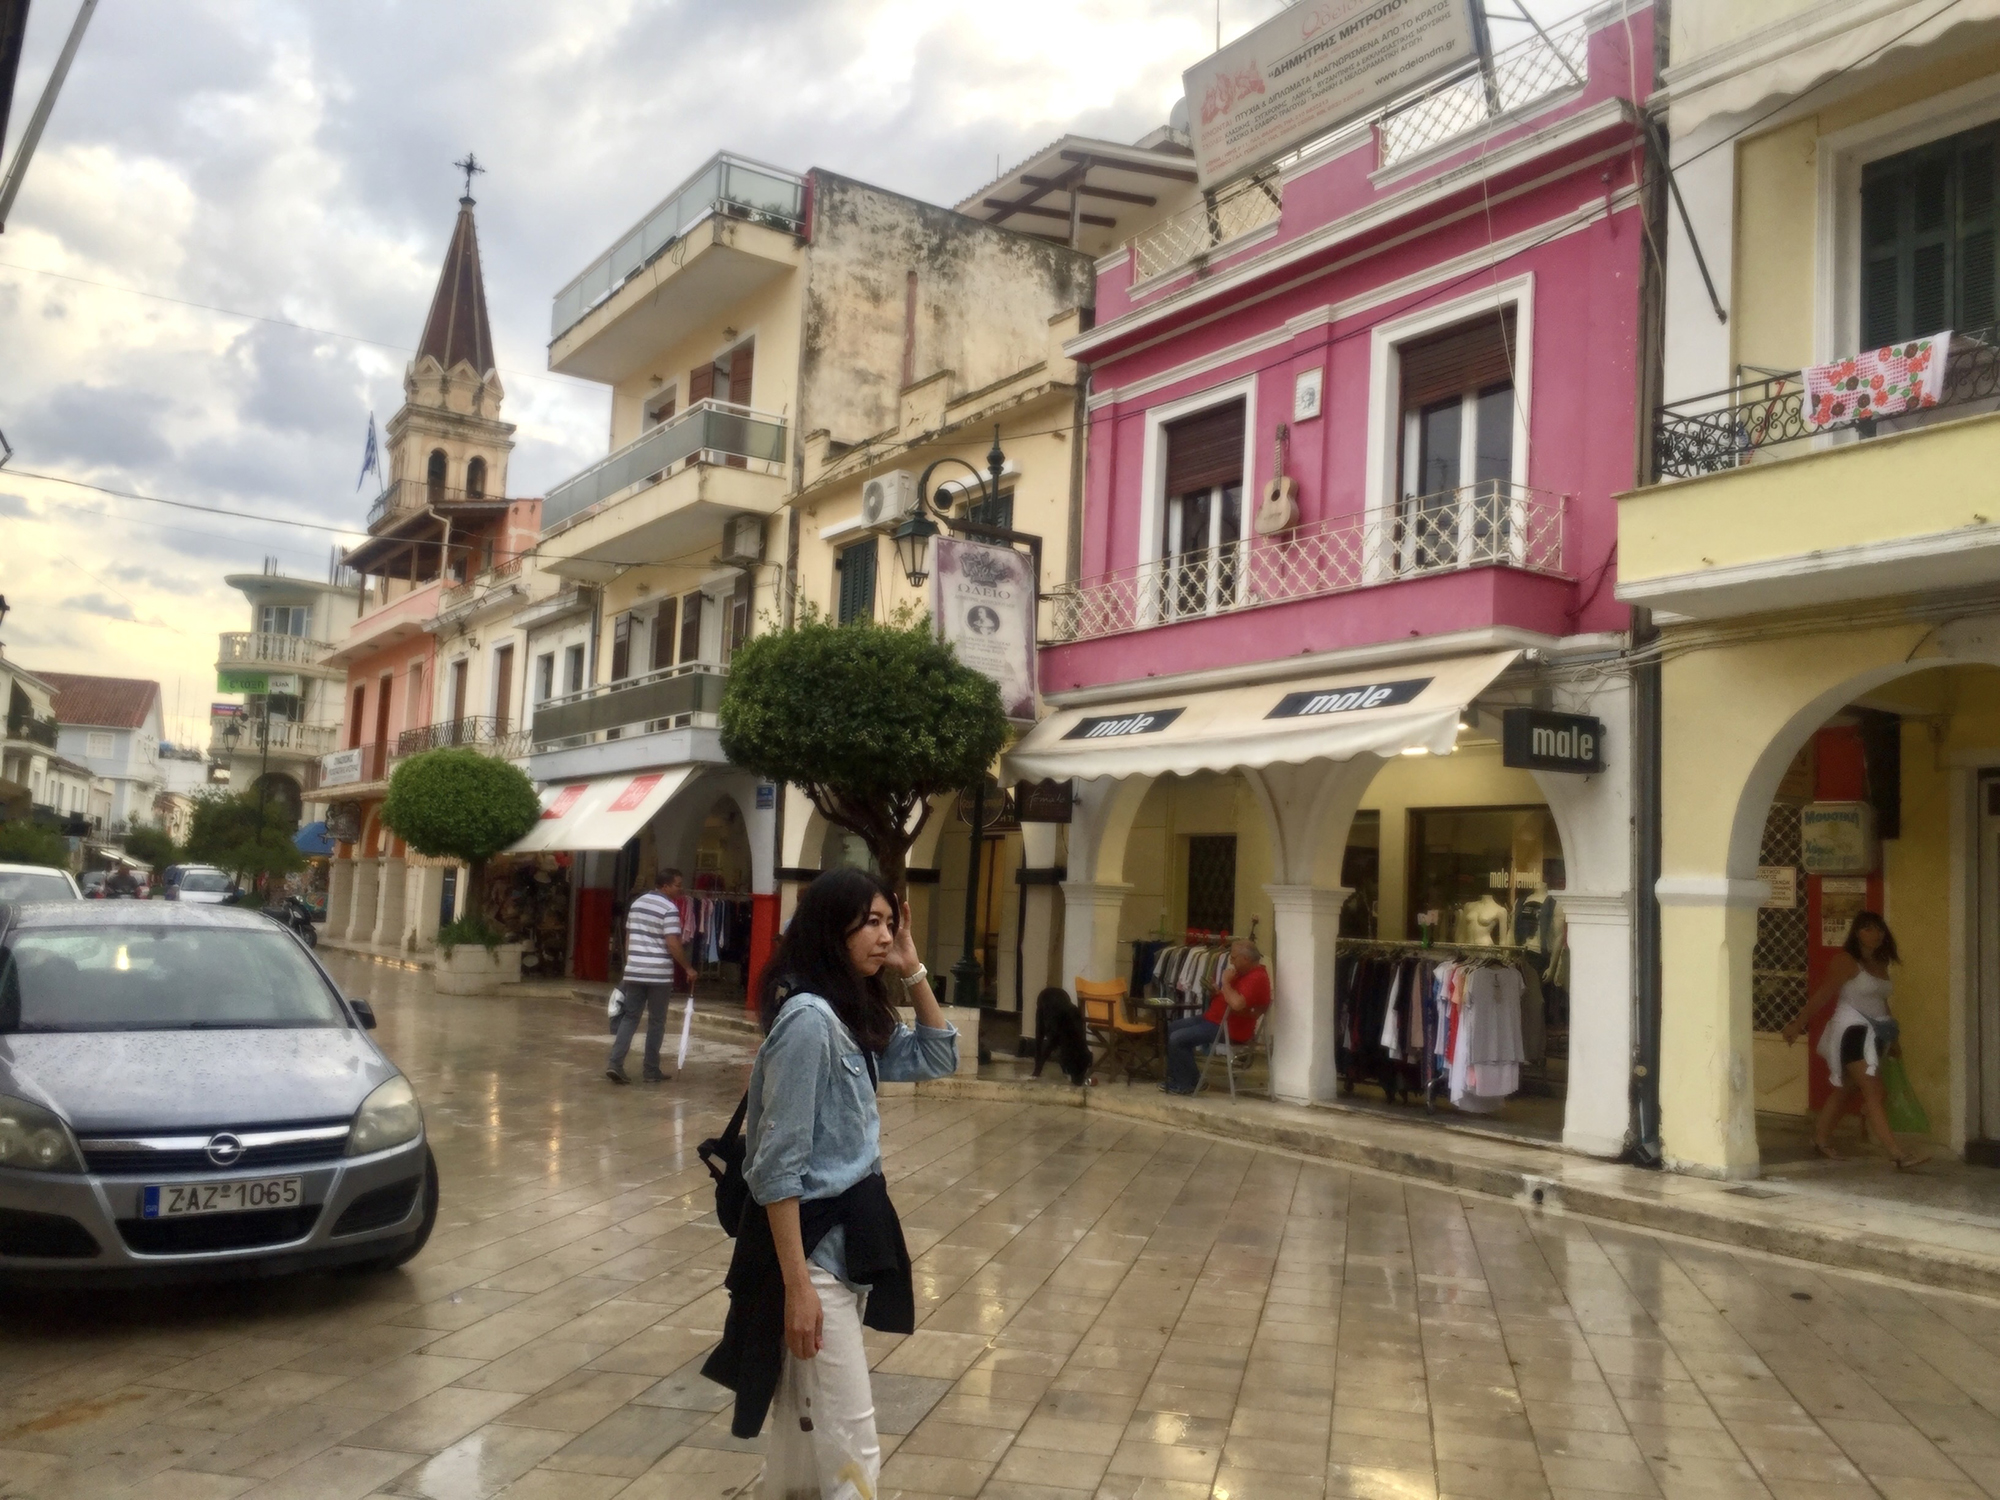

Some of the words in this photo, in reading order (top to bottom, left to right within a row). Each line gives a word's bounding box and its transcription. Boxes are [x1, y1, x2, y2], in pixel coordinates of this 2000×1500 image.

[1234, 102, 1260, 122] ΠΤΥΧΙΑ
[1267, 74, 1311, 104] ΔΙΠΛΩΜΑΤΑ
[1311, 37, 1379, 79] ΑΝΑΓΝΩΡΙΣΜΕΝΑ
[1380, 25, 1400, 41] ΑΠΟ
[1401, 18, 1413, 30] ΤΟ
[1414, 0, 1450, 23] ΚΡΑΤΟΣ
[1316, 62, 1355, 88] ΒΥΖΑΝΤΙΝΗΣ
[1415, 10, 1452, 34] ΜΟΥΣΙΚΗΣ
[1344, 47, 1399, 81] ΜΕΛΟΔΡΑΜΑΤΙΚΗ
[958, 583, 1011, 599] ΩΔΕΙΟ
[1298, 685, 1393, 715] male
[1084, 713, 1155, 738] male
[1532, 725, 1594, 761] male
